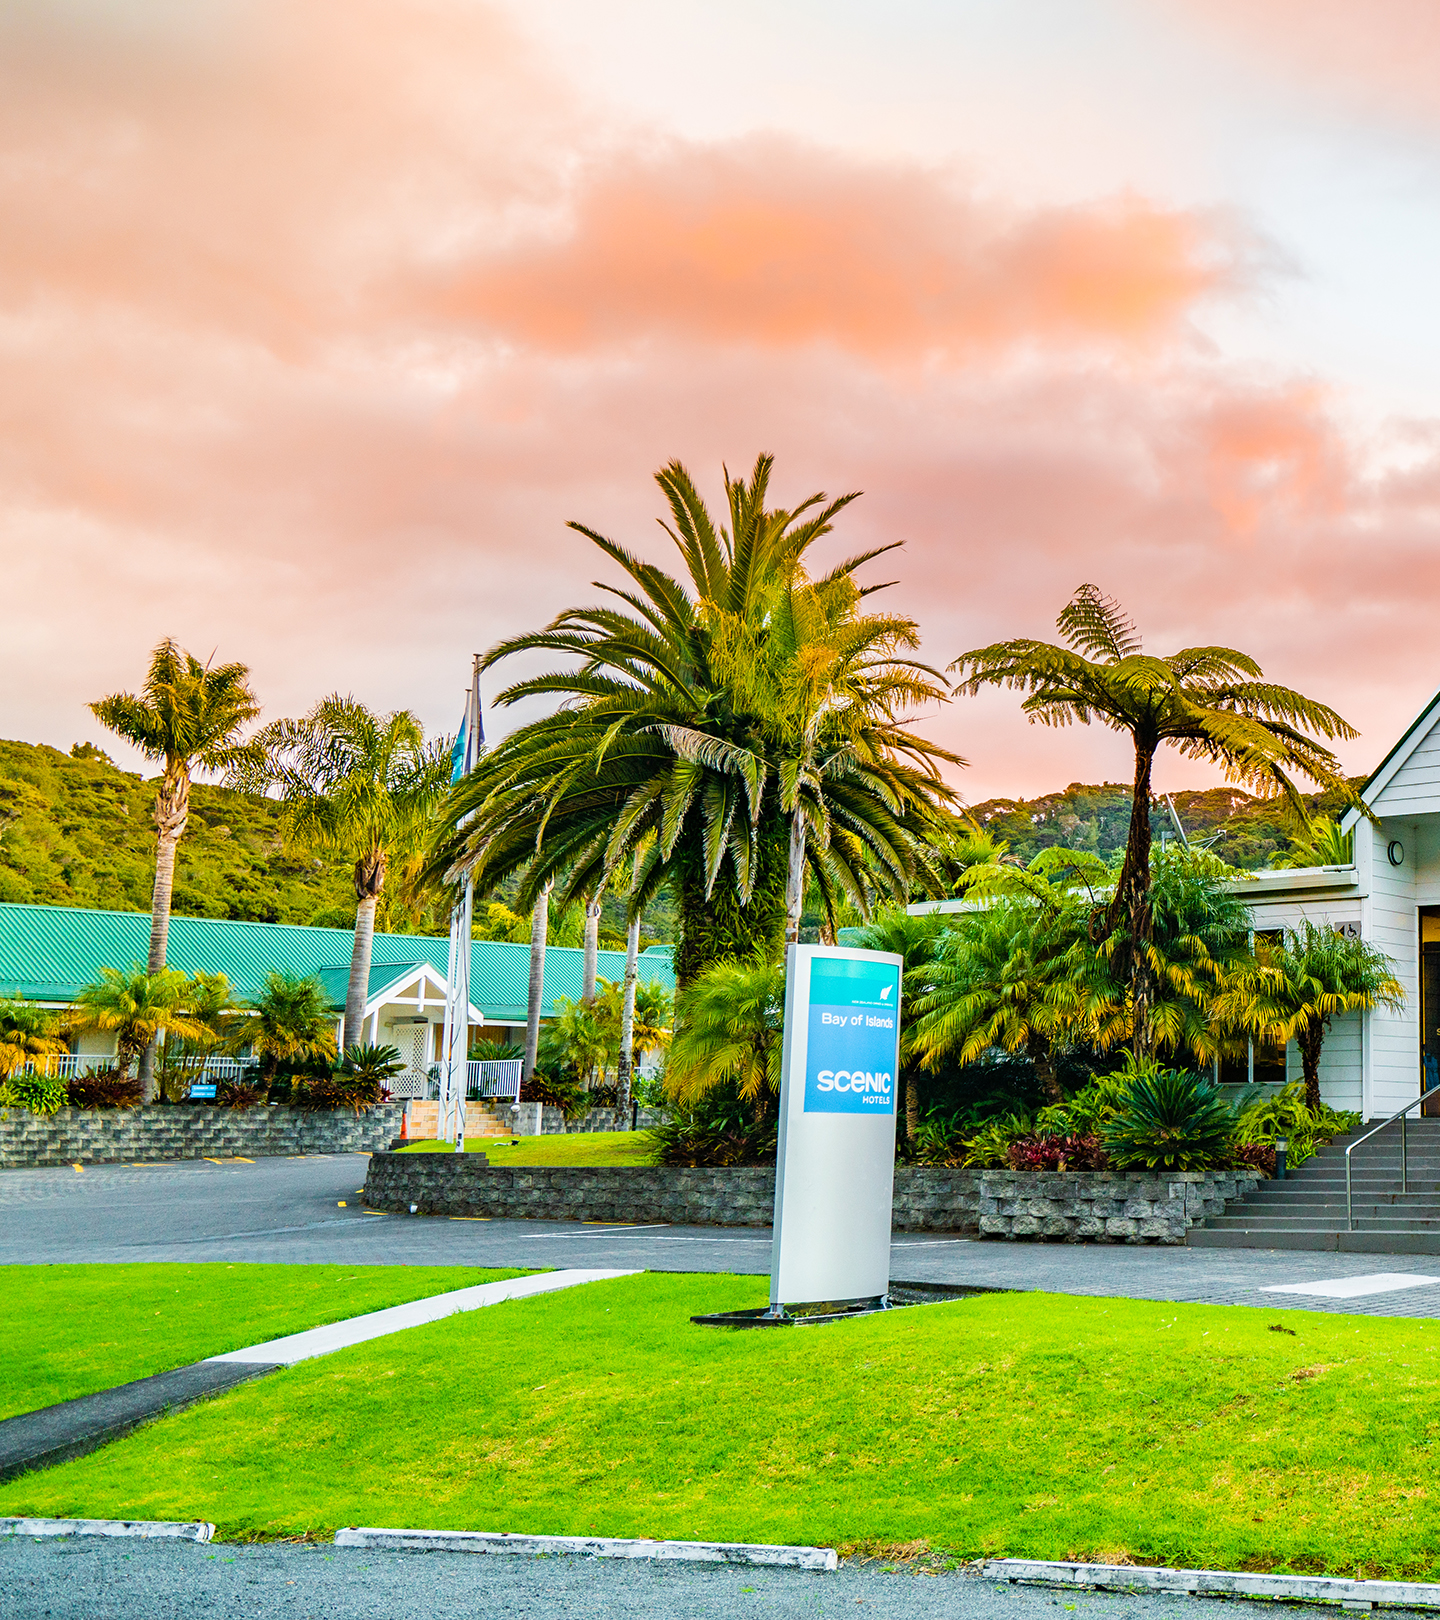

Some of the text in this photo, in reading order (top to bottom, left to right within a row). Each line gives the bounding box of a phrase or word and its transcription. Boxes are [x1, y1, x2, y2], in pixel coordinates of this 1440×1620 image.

[821, 1012, 893, 1029] Bay of Islands
[862, 1095, 890, 1105] HOTELS
